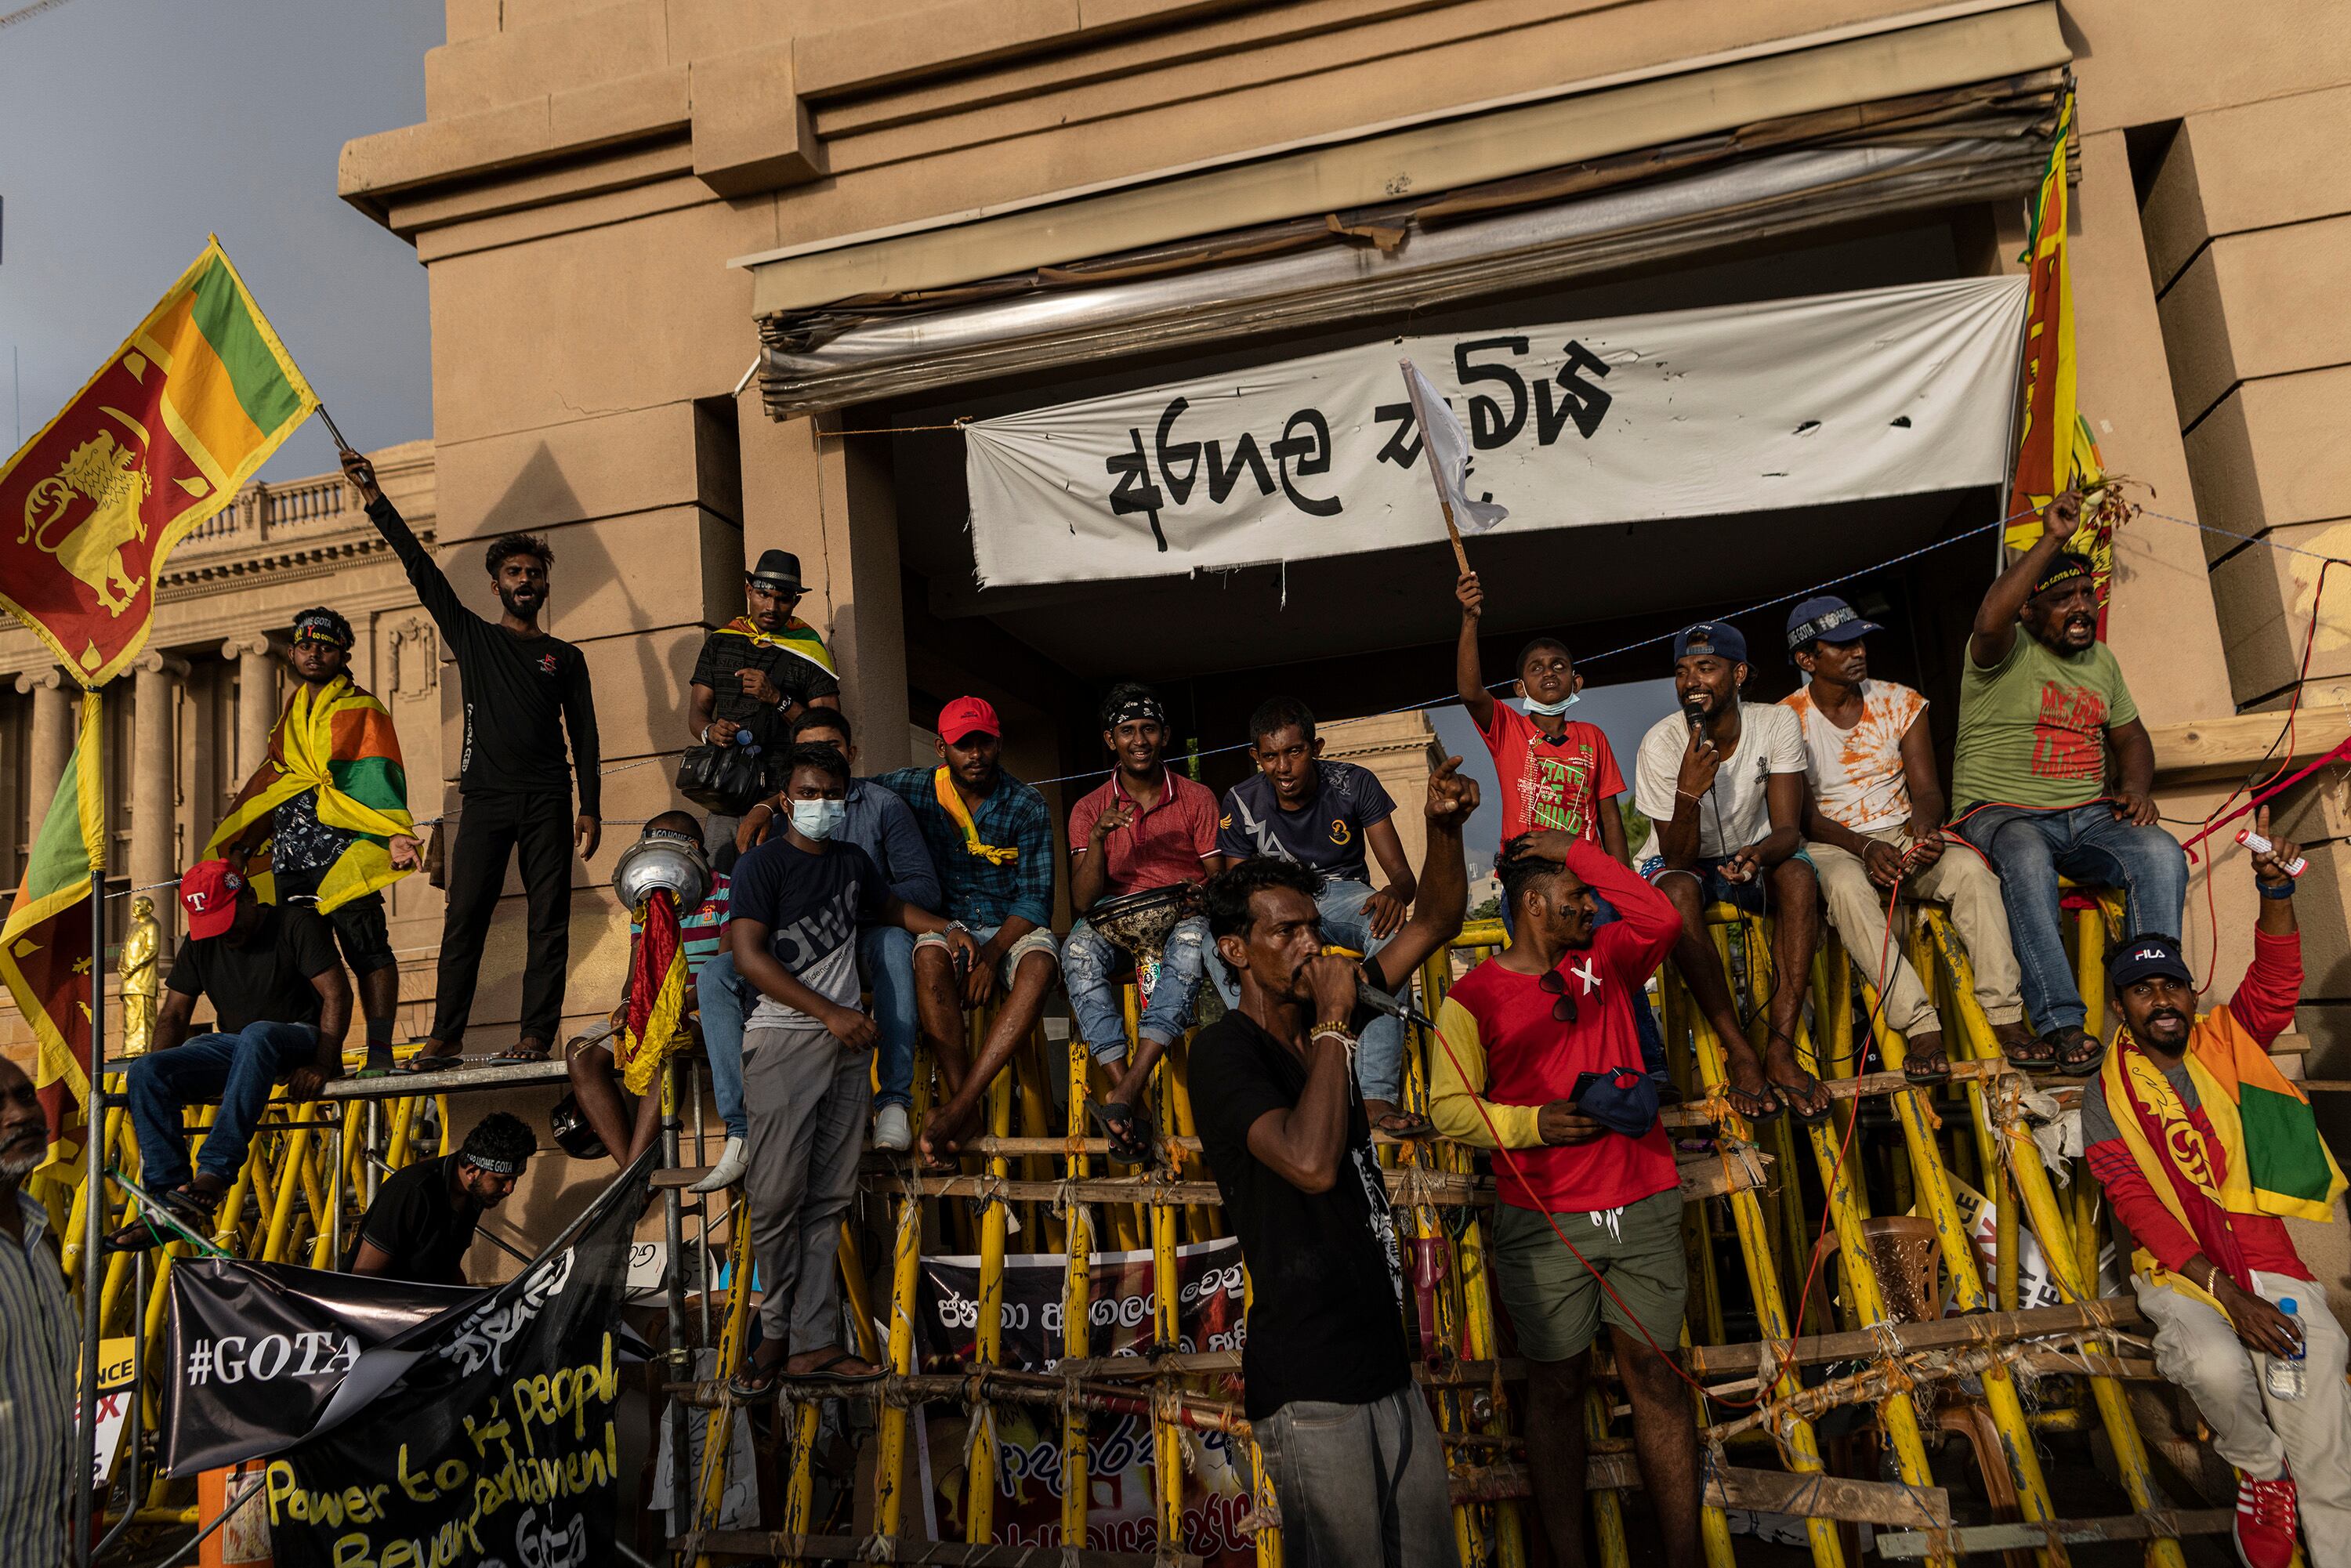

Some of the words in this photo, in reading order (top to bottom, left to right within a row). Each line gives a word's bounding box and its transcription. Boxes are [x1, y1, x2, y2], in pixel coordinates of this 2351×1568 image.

[1375, 336, 1613, 505] භමිය
[314, 616, 331, 629] GOTA
[1795, 622, 1817, 642] GOTA
[1534, 802, 1584, 835] MIND
[187, 892, 206, 912] T
[2135, 949, 2165, 961] FILA
[802, 961, 833, 986] nfidence
[494, 1161, 513, 1173] GOTA
[266, 1459, 390, 1526] Power
[397, 1443, 469, 1502] to
[513, 1331, 619, 1457] peopl
[333, 1515, 470, 1568] Beyon
